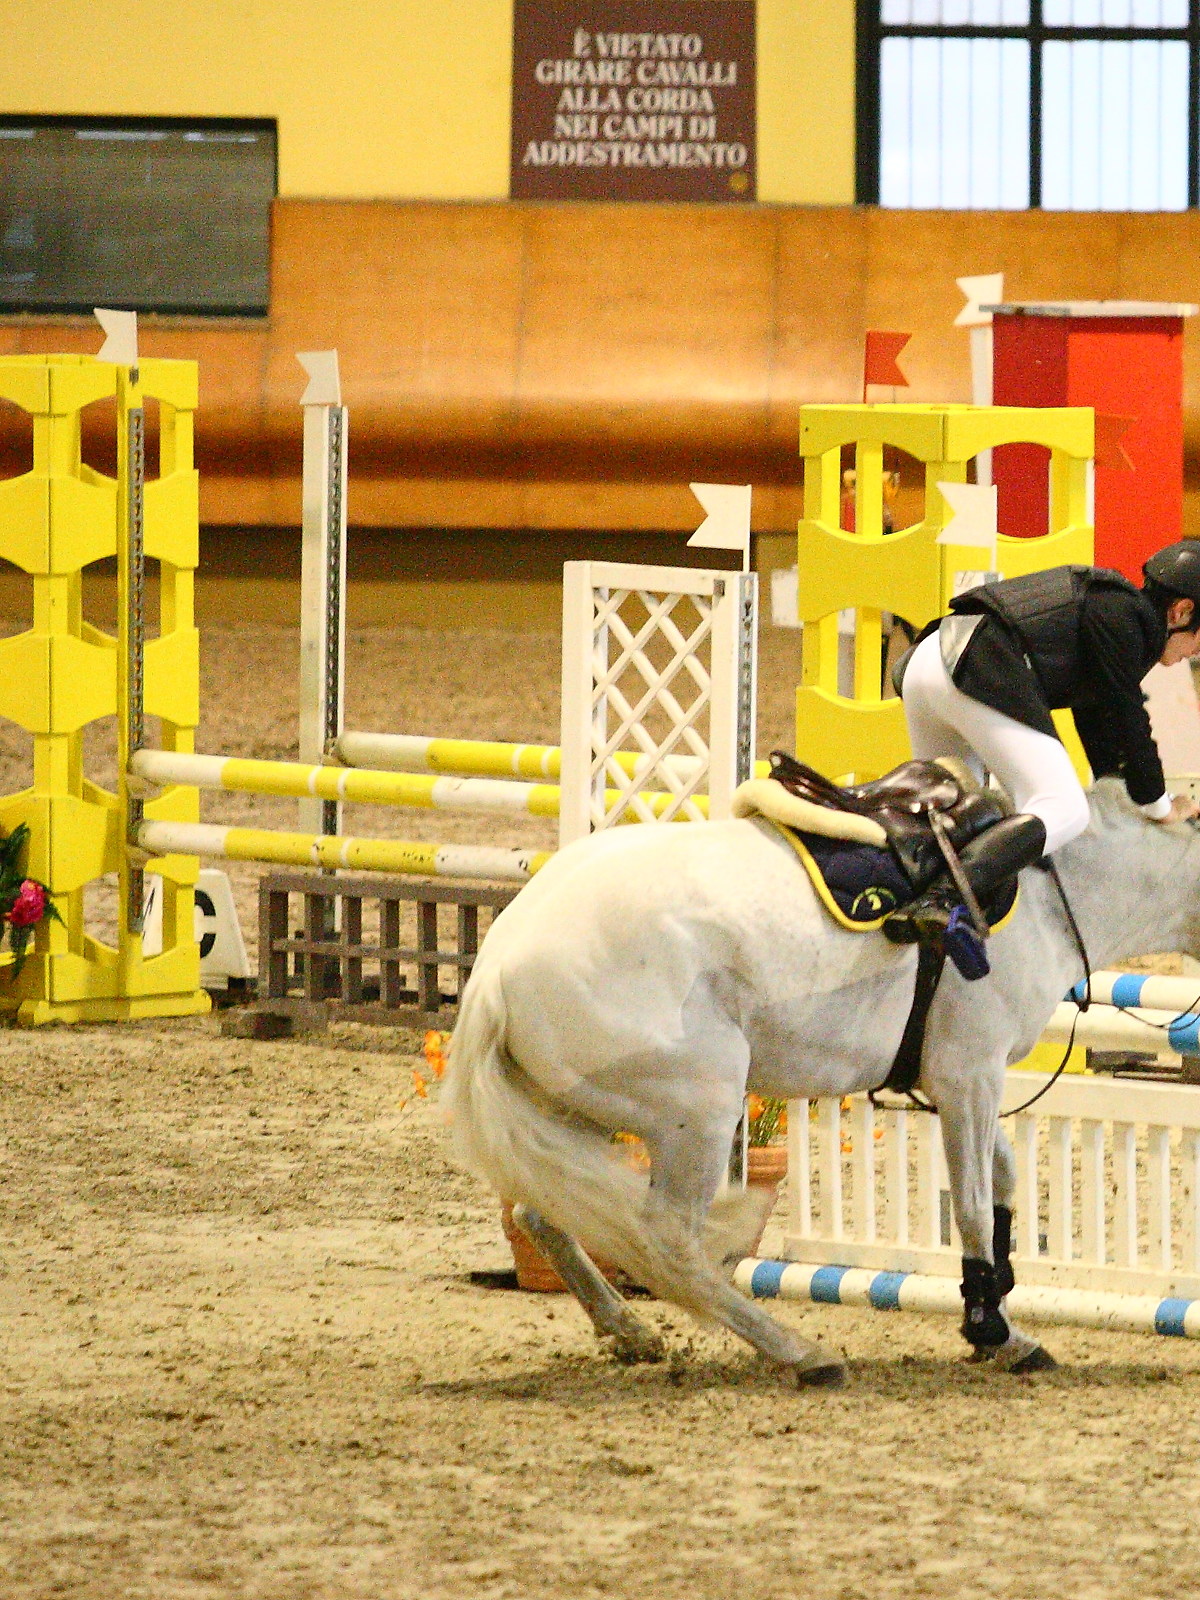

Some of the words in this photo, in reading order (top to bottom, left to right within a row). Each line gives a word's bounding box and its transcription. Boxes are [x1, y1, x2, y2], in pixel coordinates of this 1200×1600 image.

[596, 33, 703, 58] VIETATO
[535, 60, 631, 85] GIRARE
[636, 60, 738, 86] CAVALLI
[557, 87, 622, 112] ALLA
[627, 87, 715, 112] CORDA
[554, 114, 599, 139] NEI
[603, 115, 684, 140] CAMPI
[688, 116, 717, 140] DI
[523, 140, 748, 168] ADDESTRAMENTO
